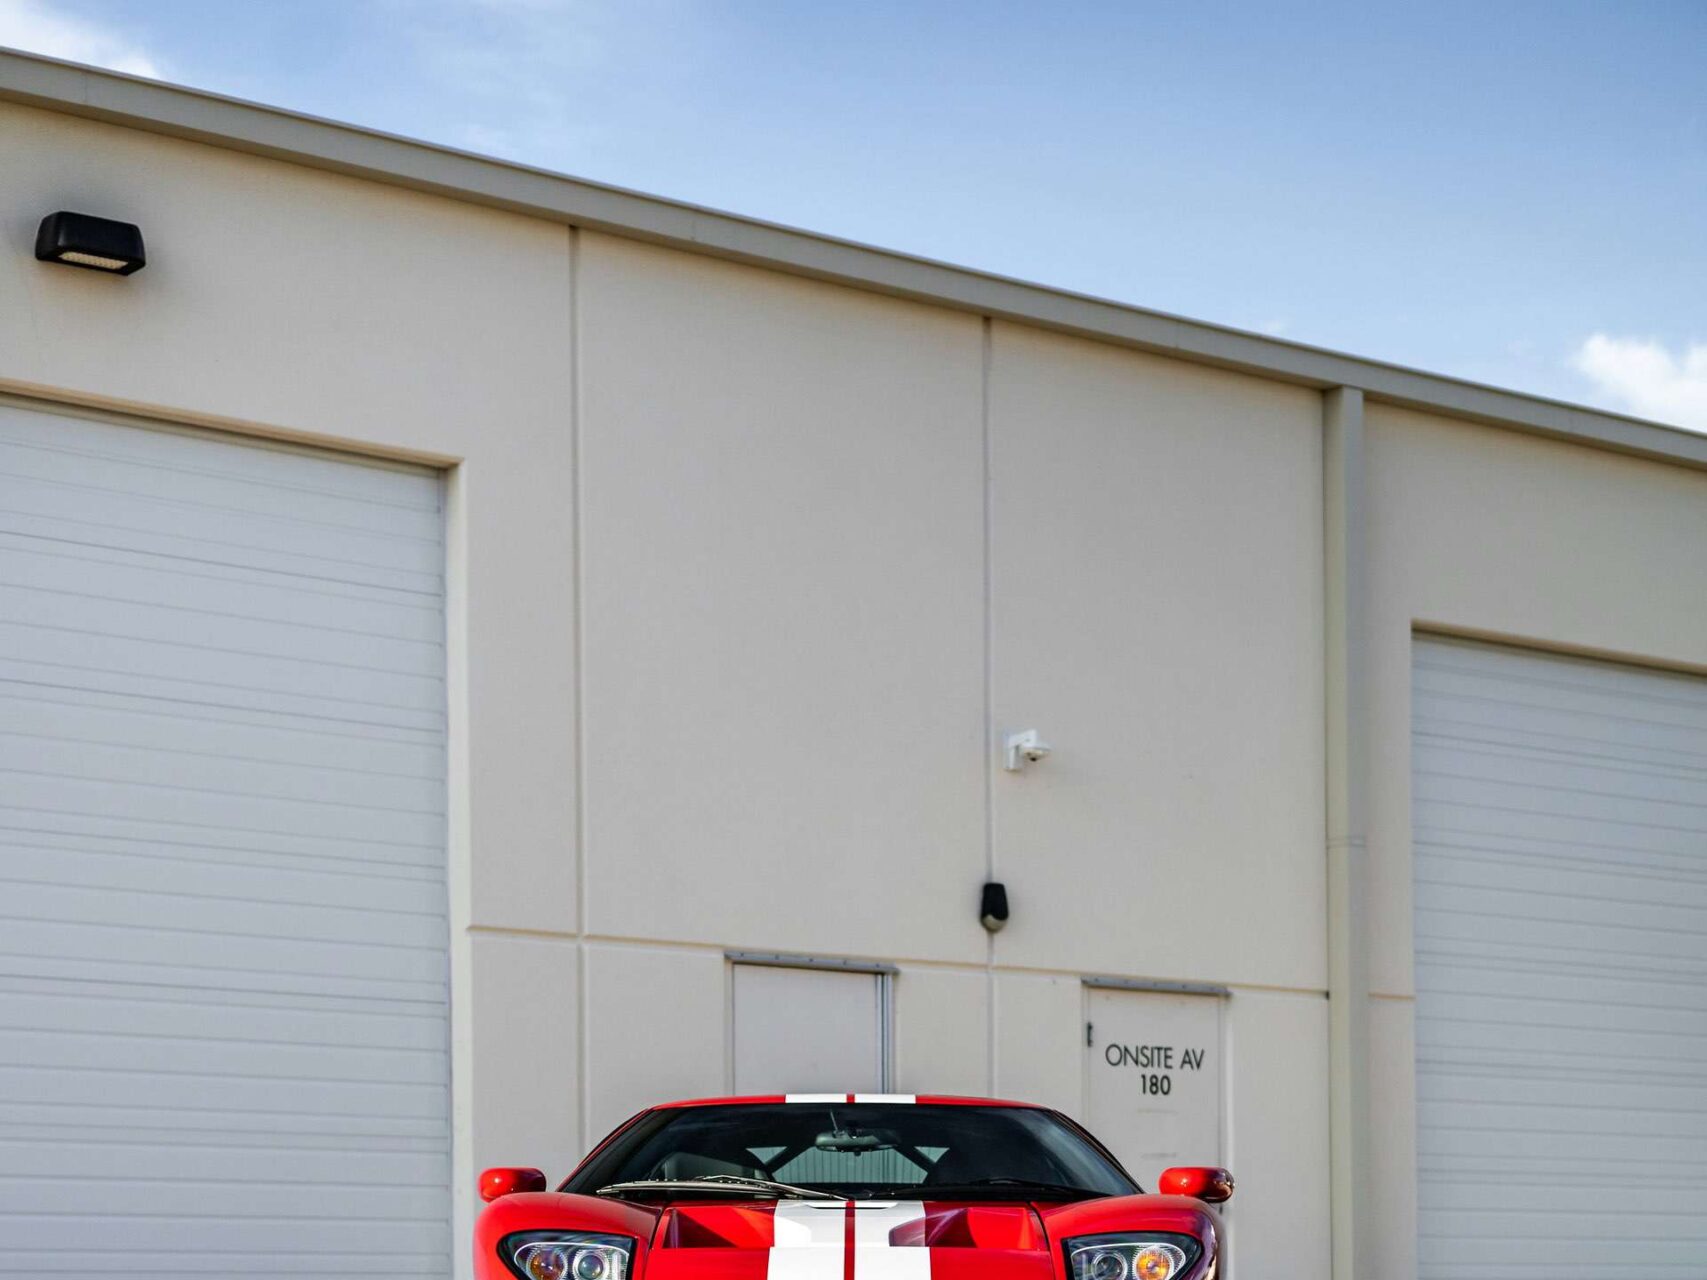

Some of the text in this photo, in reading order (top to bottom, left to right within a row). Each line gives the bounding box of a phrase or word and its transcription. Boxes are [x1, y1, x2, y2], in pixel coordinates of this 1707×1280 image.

[1105, 1043, 1205, 1070] ONSITE AV
[1141, 1074, 1171, 1095] 180
